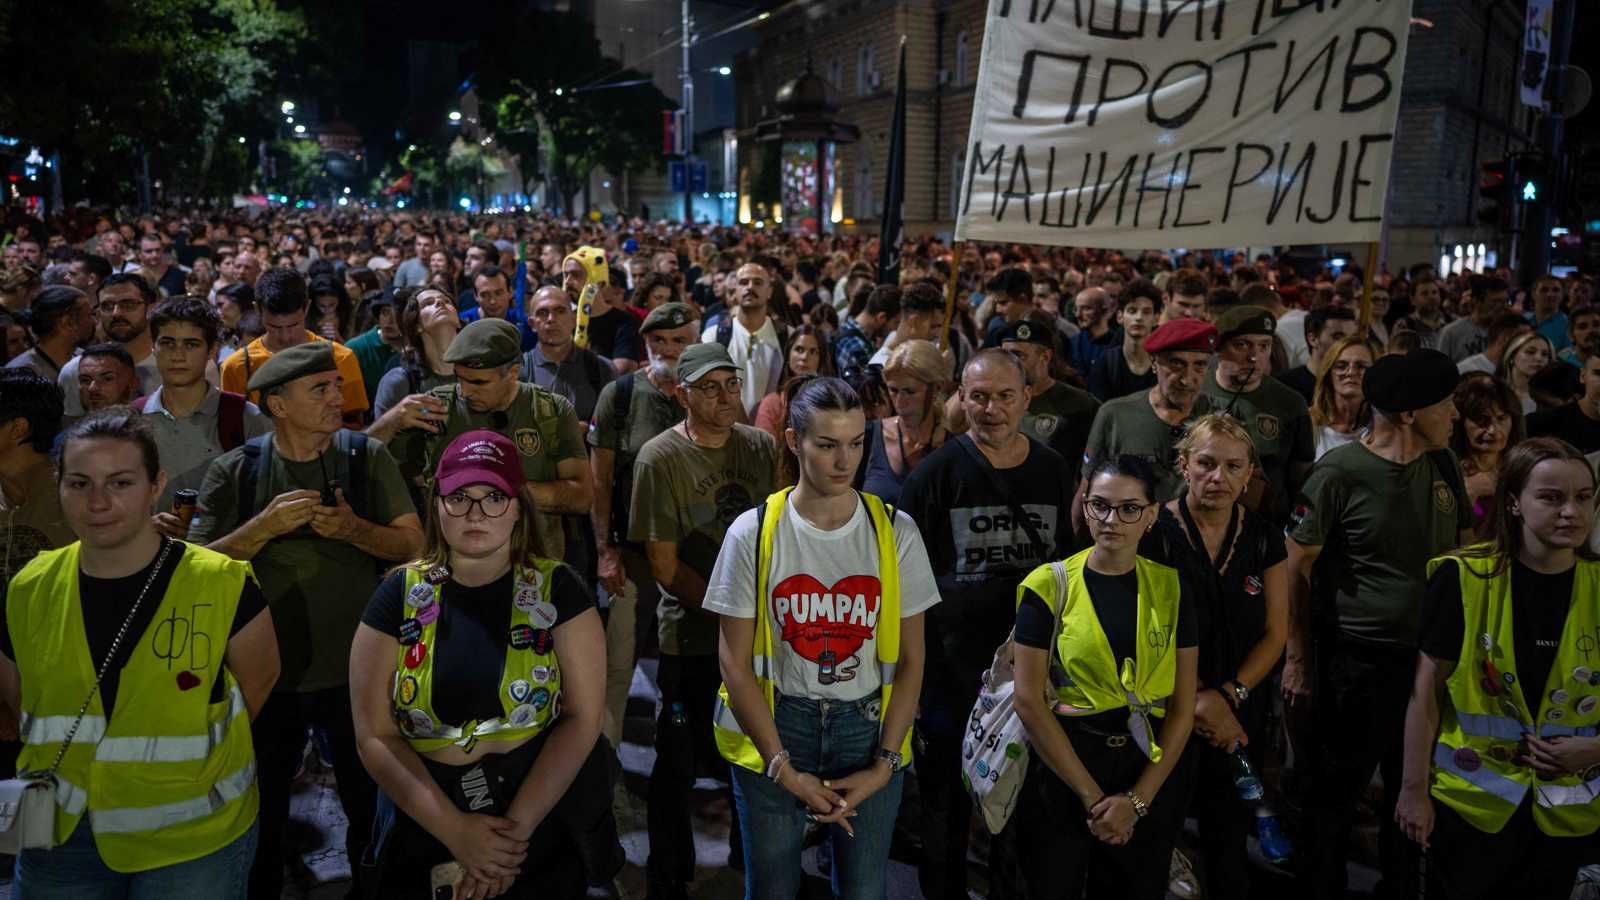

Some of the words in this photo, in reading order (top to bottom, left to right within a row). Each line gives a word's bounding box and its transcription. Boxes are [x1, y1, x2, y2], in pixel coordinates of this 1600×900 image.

[1012, 27, 1397, 129] ПРОТИВ
[962, 133, 1393, 230] МАШИНЕРИЈЕ
[152, 603, 213, 671] ФБ
[775, 591, 881, 628] PUMPAJ
